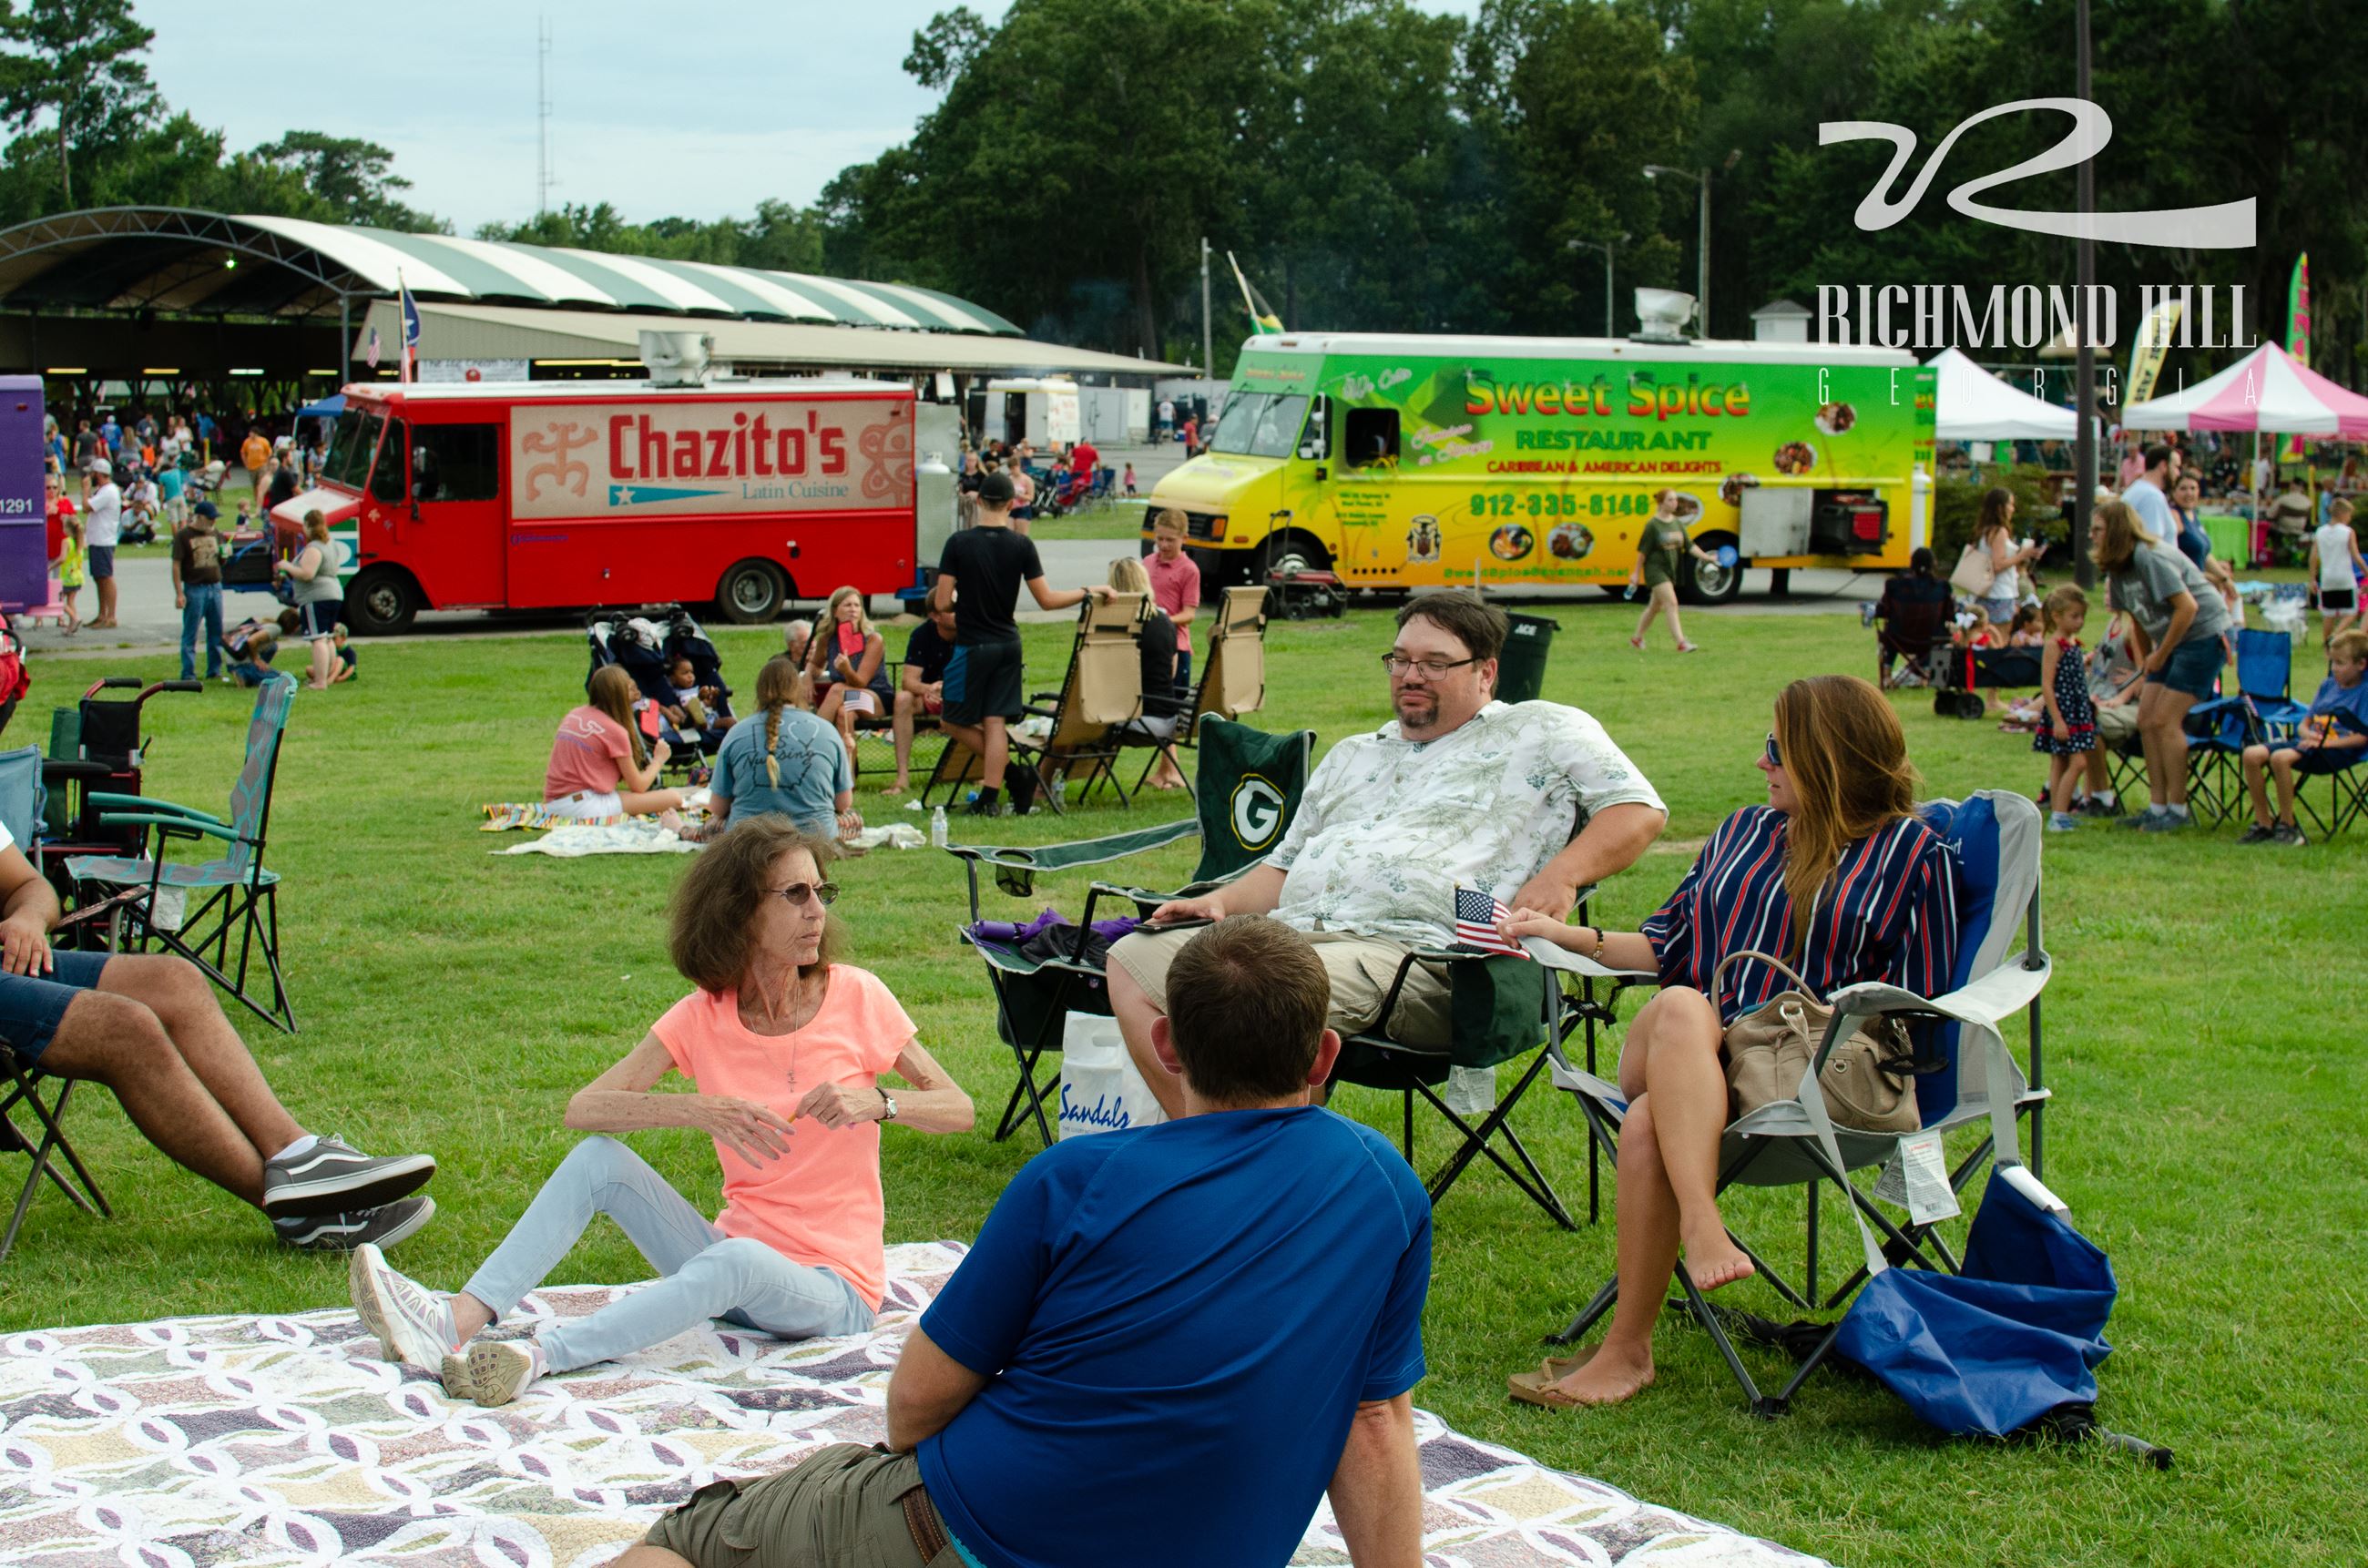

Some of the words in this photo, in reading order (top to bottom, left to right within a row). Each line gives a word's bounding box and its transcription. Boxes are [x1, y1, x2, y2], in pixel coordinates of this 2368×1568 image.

[1465, 370, 1613, 416] Sweet
[1628, 371, 1750, 421] Spice
[609, 411, 848, 480] Chazito's
[1516, 430, 1712, 451] RESTAURANT
[1487, 460, 1566, 473] CARIBBEAN
[1567, 461, 1578, 473] &
[1583, 461, 1659, 473] AMERICAN
[1660, 461, 1721, 473] DELIGHTS
[742, 483, 784, 500] Latin
[788, 482, 849, 499] Cuisine
[743, 748, 816, 770] Nusing
[1235, 780, 1283, 843] G
[1059, 1084, 1131, 1130] Sandals
